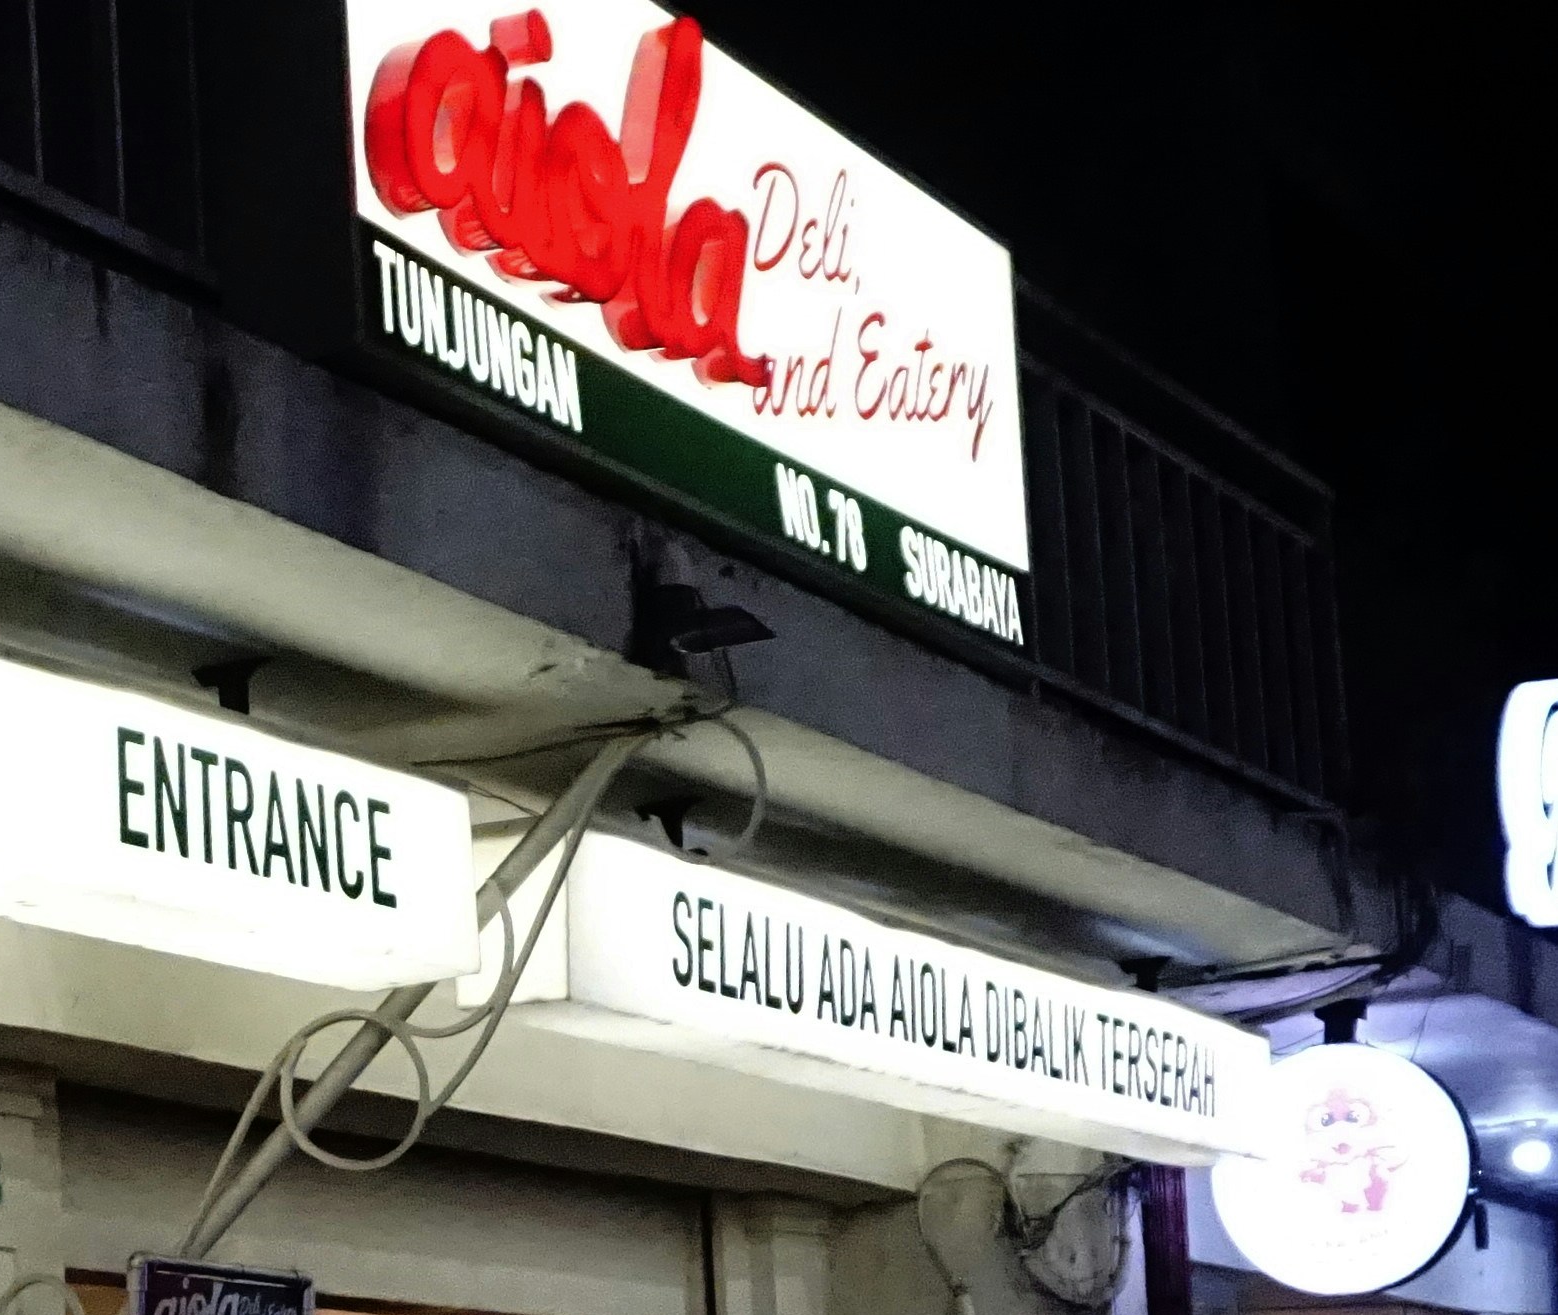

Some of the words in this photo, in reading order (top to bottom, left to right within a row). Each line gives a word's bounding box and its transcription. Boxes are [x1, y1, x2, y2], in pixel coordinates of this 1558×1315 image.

[752, 160, 862, 296] Deli,
[373, 238, 584, 434] TUNJUNGAN
[900, 524, 1025, 647] SURABAYA
[752, 306, 844, 418] and
[853, 311, 994, 463] Eatery
[116, 725, 398, 910] ENTRANCE
[671, 890, 805, 1015] SELALU
[816, 933, 880, 1035] ADA
[889, 953, 977, 1059] AIOLA
[984, 980, 1090, 1087] DIBALIK
[1095, 1012, 1217, 1118] TERSERAH
